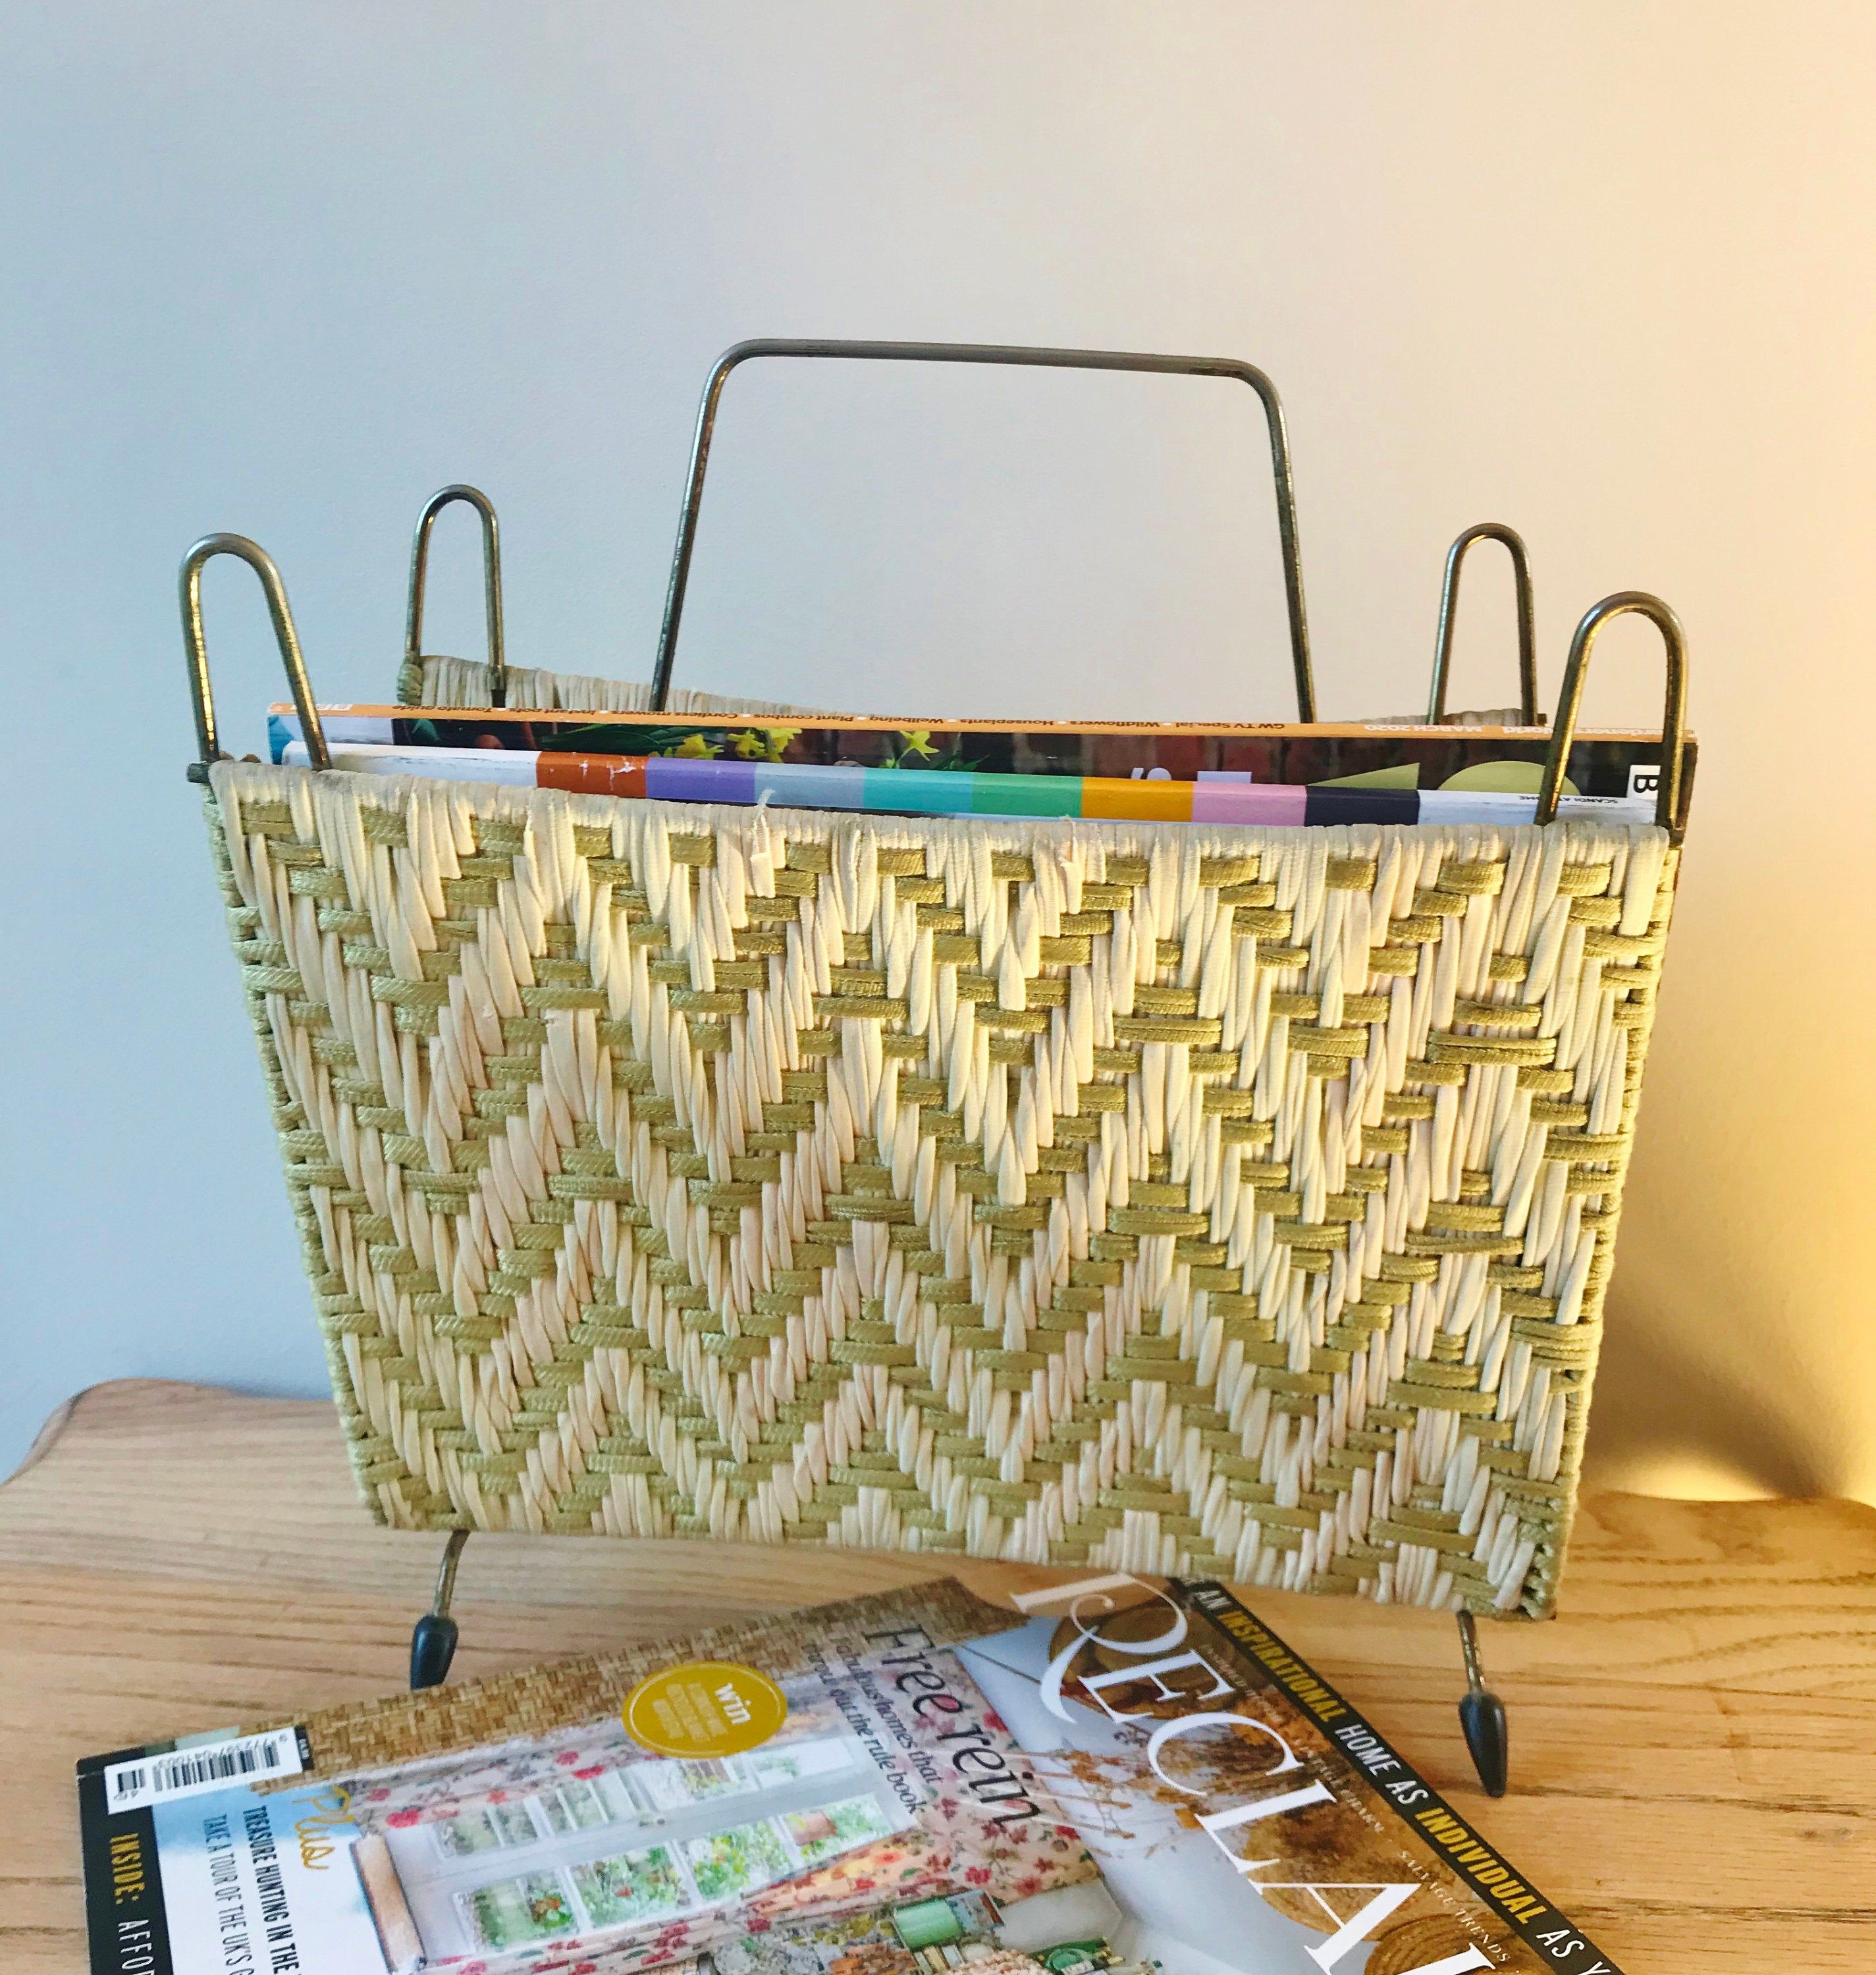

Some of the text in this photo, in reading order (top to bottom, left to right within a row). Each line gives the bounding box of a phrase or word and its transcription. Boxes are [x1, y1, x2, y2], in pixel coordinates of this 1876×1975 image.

[714, 1681, 751, 1725] win
[861, 1623, 1042, 1834] Free rein
[829, 1688, 859, 1713] out
[846, 1712, 874, 1737] the
[863, 1737, 896, 1771] rule
[886, 1771, 927, 1815] book
[874, 1698, 919, 1750] homes
[907, 1750, 943, 1784] that
[1194, 1590, 1231, 1612] AN
[1218, 1610, 1347, 1723] INSPIRATIONAL
[1334, 1724, 1402, 1777] HOME
[1384, 1779, 1430, 1806] AS
[1414, 1806, 1548, 1925] INDIVIDUAL
[1535, 1928, 1585, 1959] AS
[203, 1814, 230, 1843] TAKE
[207, 1843, 232, 1854] A
[292, 1785, 356, 1871] Plus
[110, 1833, 146, 1905] INSIDE:
[209, 1852, 238, 1885] TOUR
[215, 1885, 242, 1902] OF
[242, 1804, 300, 1974] TREASURE HUNTING IN THE
[218, 1904, 247, 1933] THE
[1399, 1849, 1511, 1964] SALVAGE TRENDS
[222, 1932, 253, 1967] UK'S
